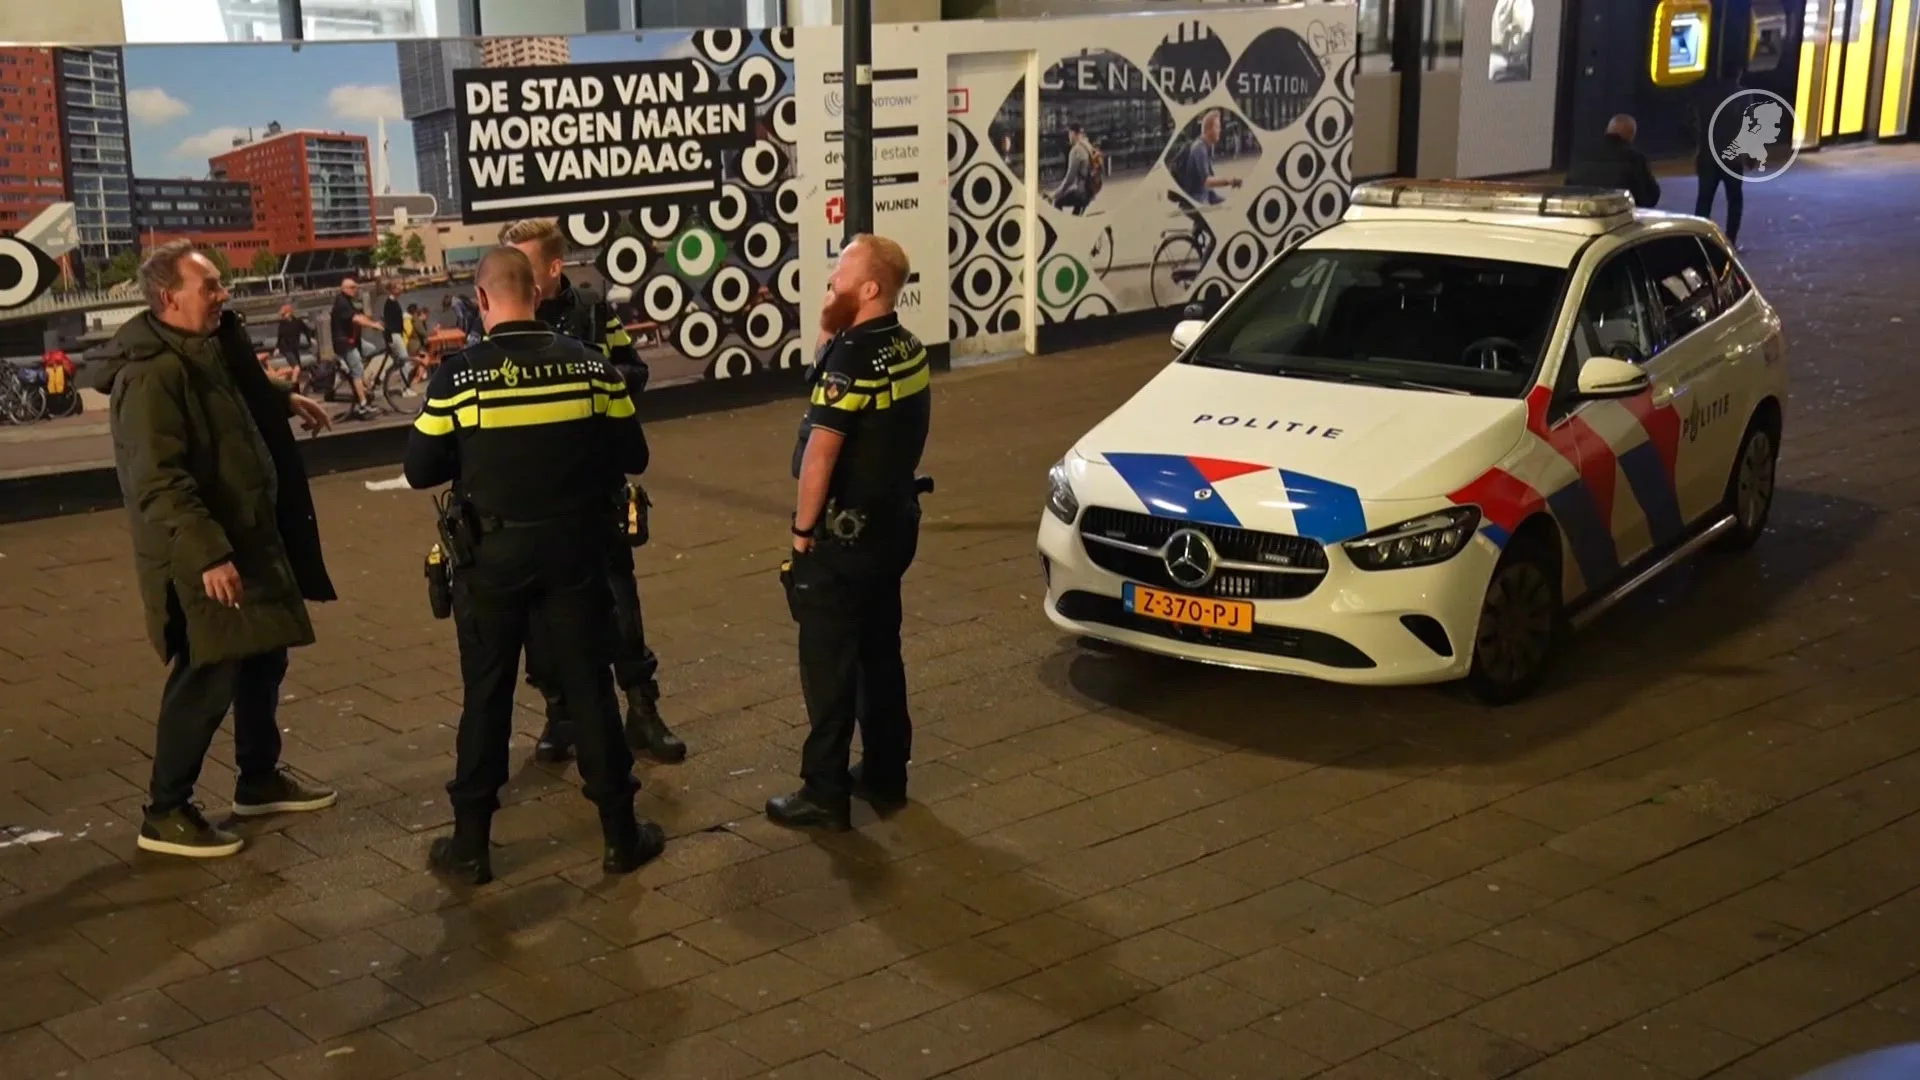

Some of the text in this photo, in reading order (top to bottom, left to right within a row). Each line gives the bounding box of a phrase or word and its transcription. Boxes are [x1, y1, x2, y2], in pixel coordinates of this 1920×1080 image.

[465, 71, 684, 115] DE STAD VAN
[1237, 71, 1309, 95] STATION
[468, 102, 747, 153] MORGEN MAKEN
[468, 153, 525, 189] WE
[534, 139, 713, 183] VANDAAG.
[881, 145, 919, 161] estate
[875, 198, 918, 213] WIJNEN
[1193, 413, 1344, 440] POLITIE
[1143, 591, 1240, 627] Z-370-PJ
